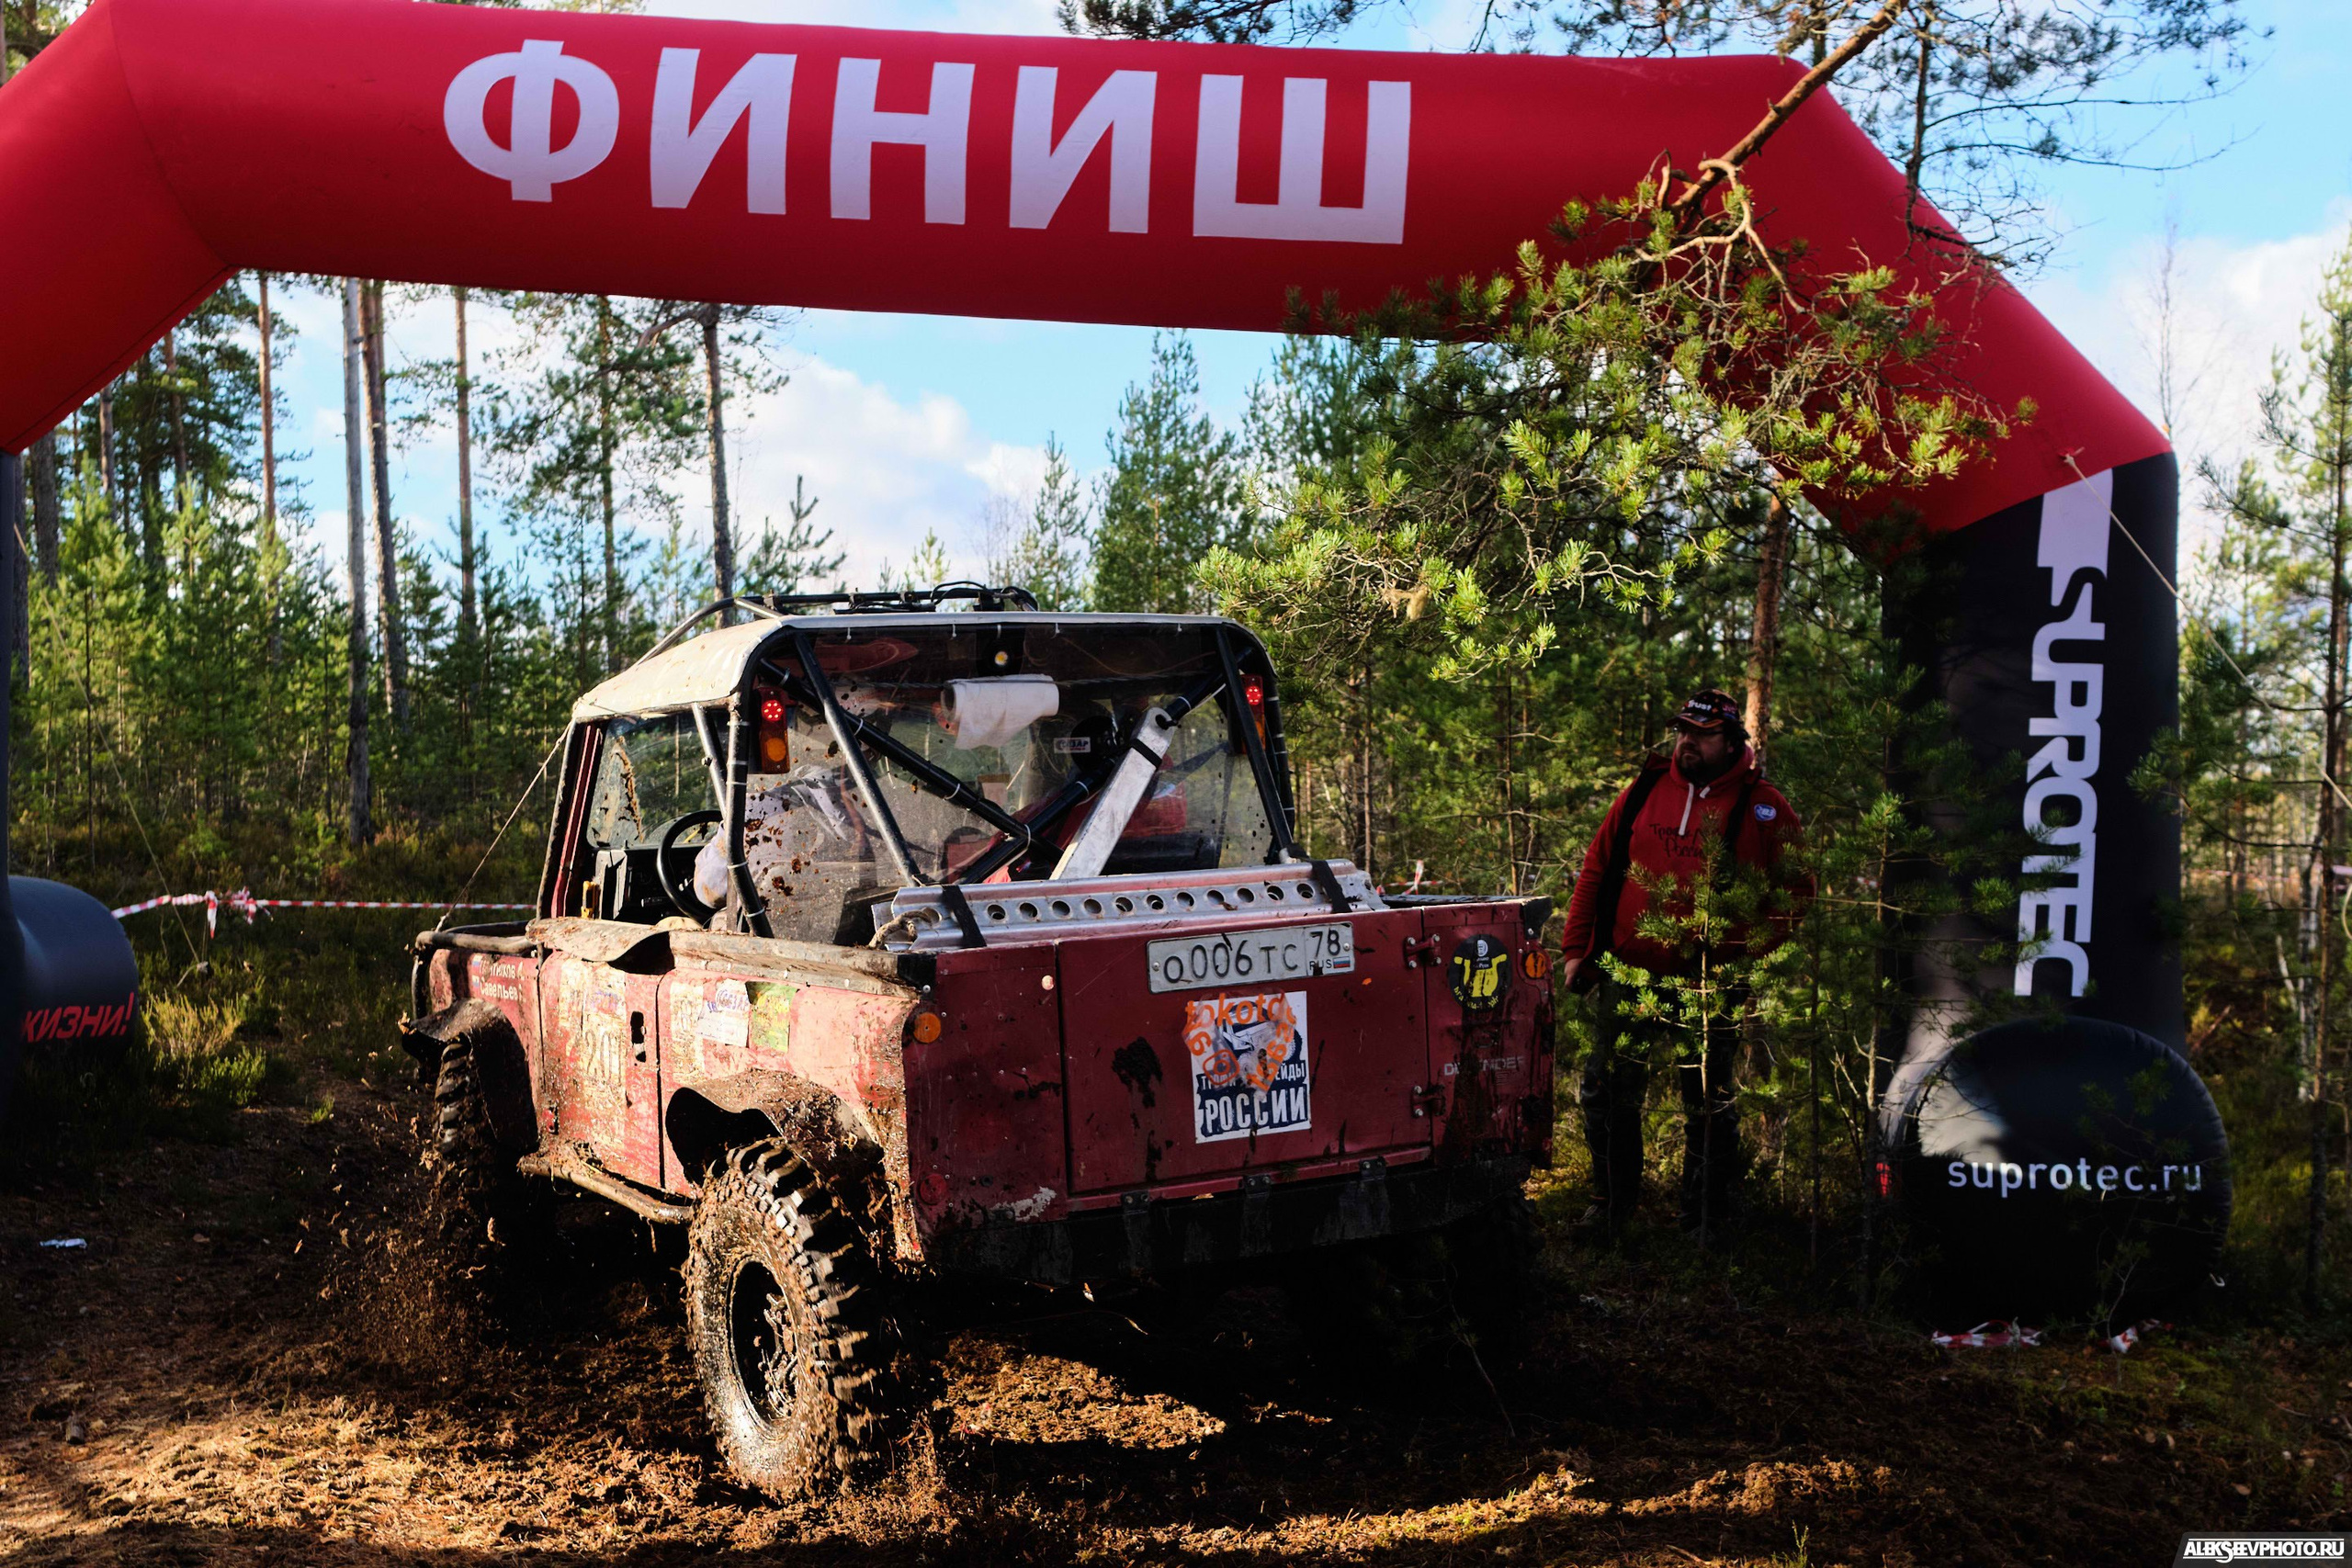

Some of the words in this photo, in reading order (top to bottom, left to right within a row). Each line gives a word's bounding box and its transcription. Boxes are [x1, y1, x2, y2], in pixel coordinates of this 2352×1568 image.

[443, 38, 1412, 245] ФИНИШ
[2013, 549, 2111, 998] SUPROTEC
[1309, 929, 1341, 957] 78
[1204, 1087, 1306, 1134] РОССИИ
[1947, 1156, 2203, 1199] suprotec.ru
